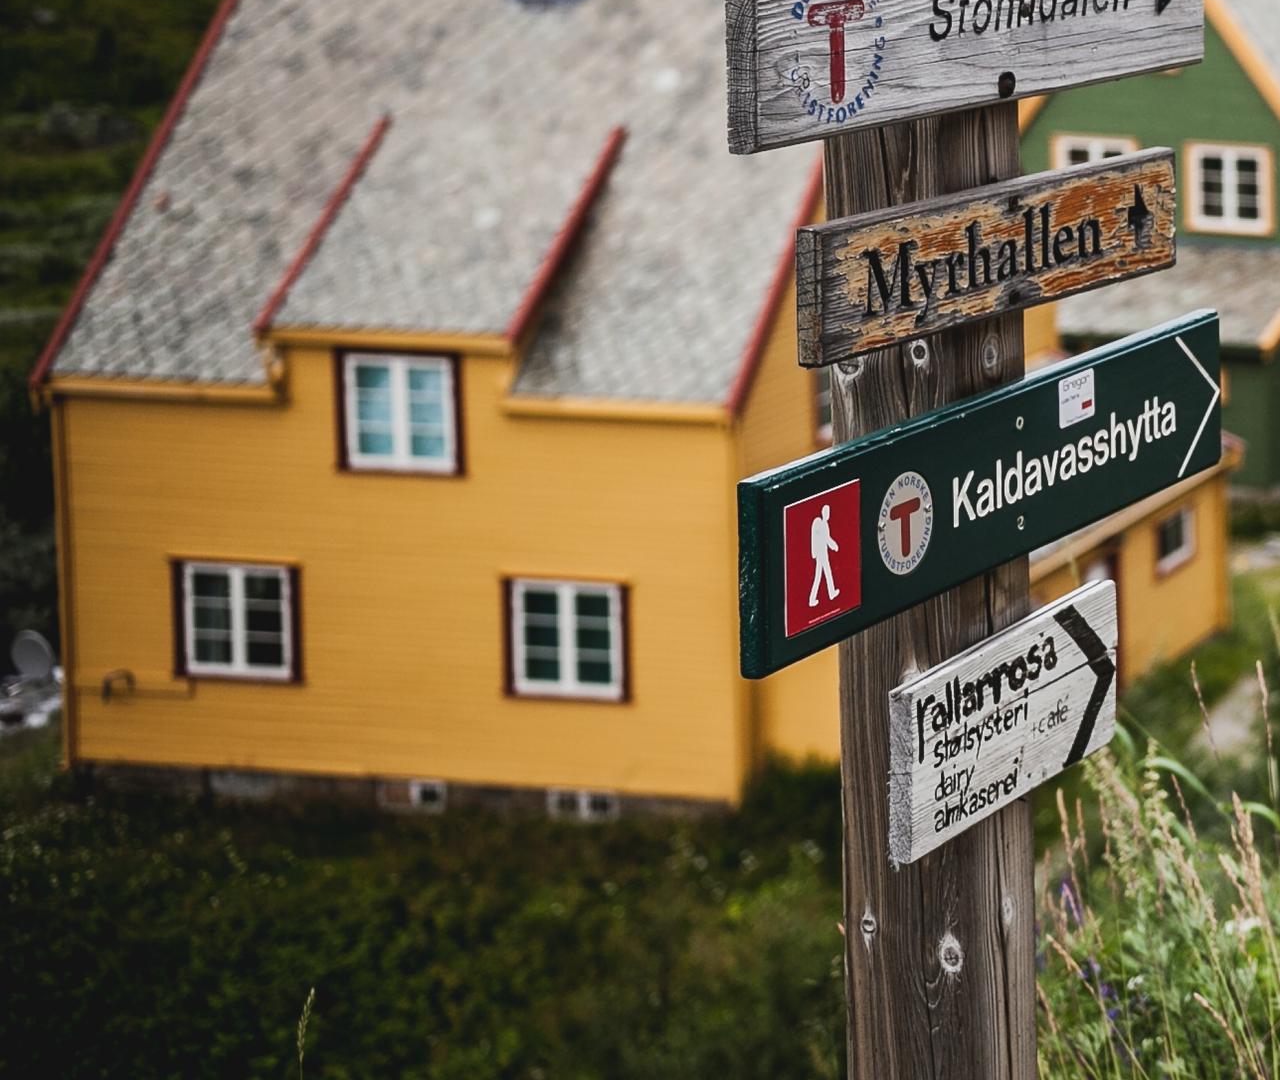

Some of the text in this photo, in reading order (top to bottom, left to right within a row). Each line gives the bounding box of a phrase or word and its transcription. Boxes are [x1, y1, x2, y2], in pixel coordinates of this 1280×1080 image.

[862, 202, 1104, 327] Myrhallen
[881, 475, 930, 518] DEN NORSKE
[951, 395, 1177, 529] Kaldavasshytta
[933, 687, 1029, 769] stølsysteri
[934, 763, 976, 802] dairy
